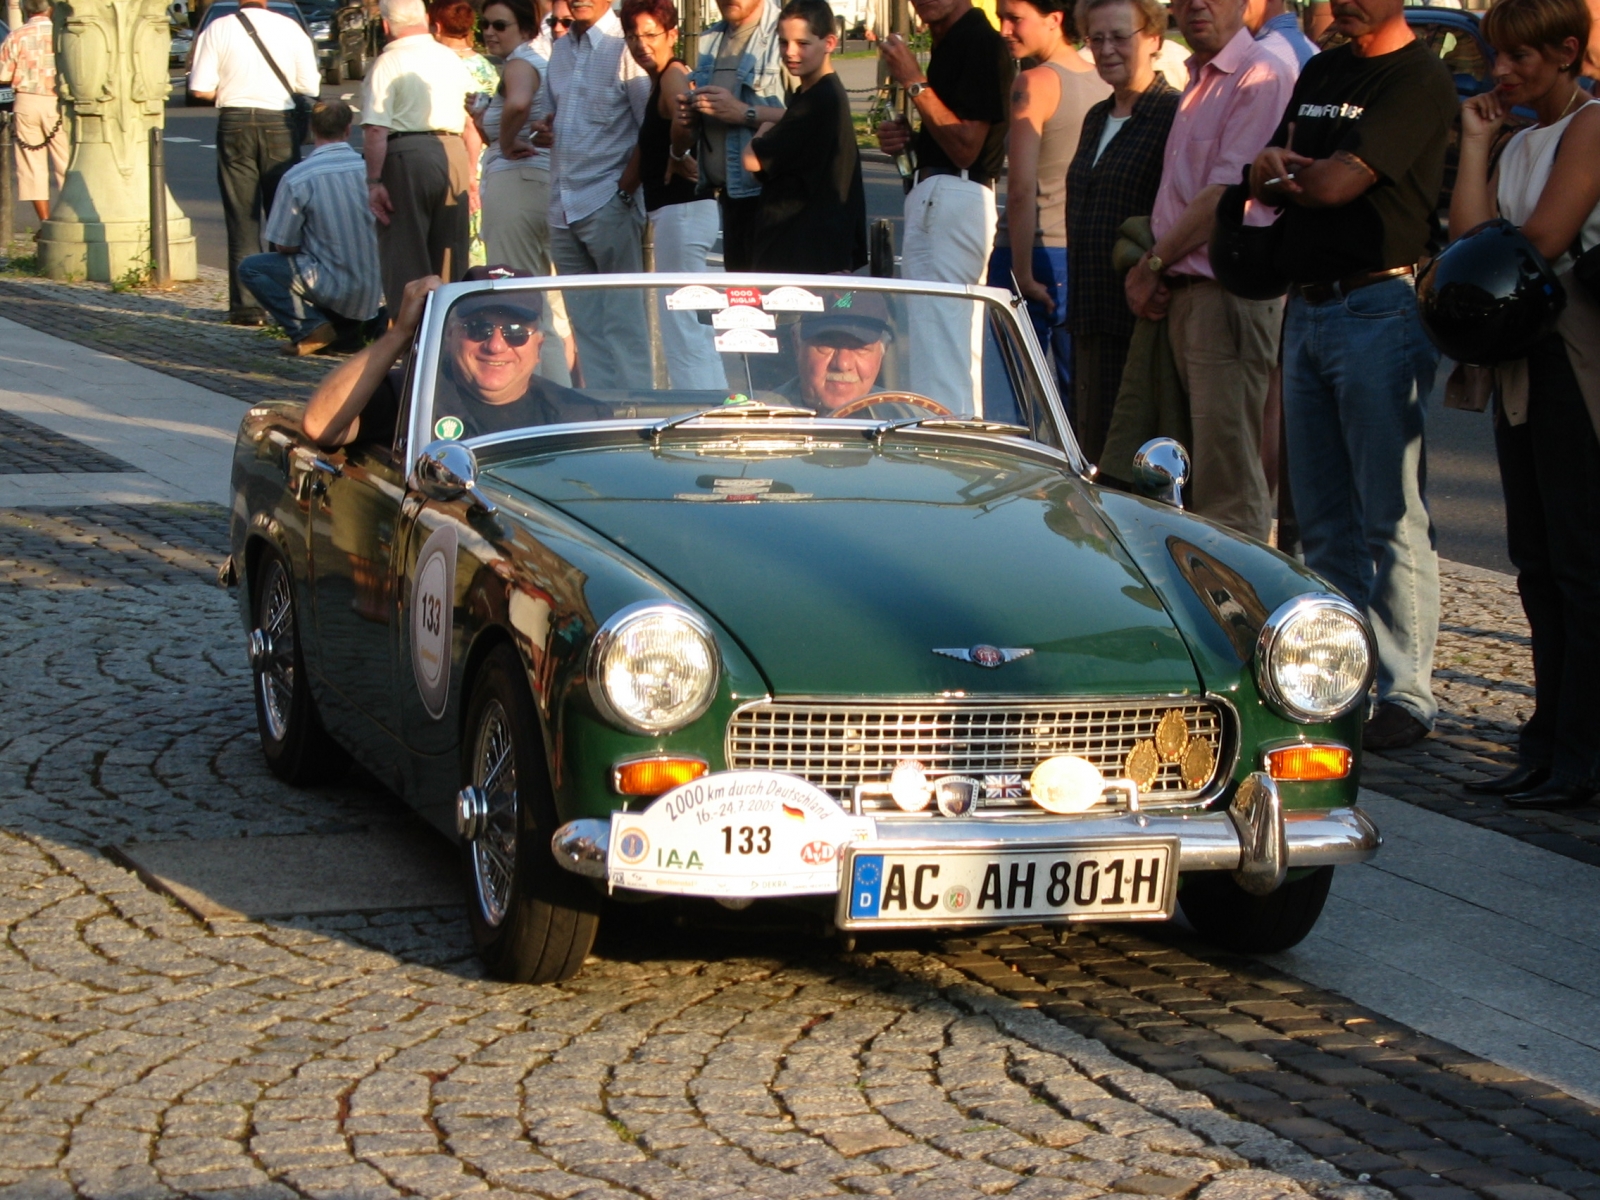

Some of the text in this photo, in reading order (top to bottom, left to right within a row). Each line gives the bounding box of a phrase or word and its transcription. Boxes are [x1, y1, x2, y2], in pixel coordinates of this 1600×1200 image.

[422, 592, 442, 637] 133
[665, 779, 834, 822] 2000 km durch Deutschland
[721, 825, 772, 855] 133
[656, 848, 704, 870] IAA
[762, 880, 787, 889] DEKRA
[859, 858, 1160, 911] D AC AH 801H
